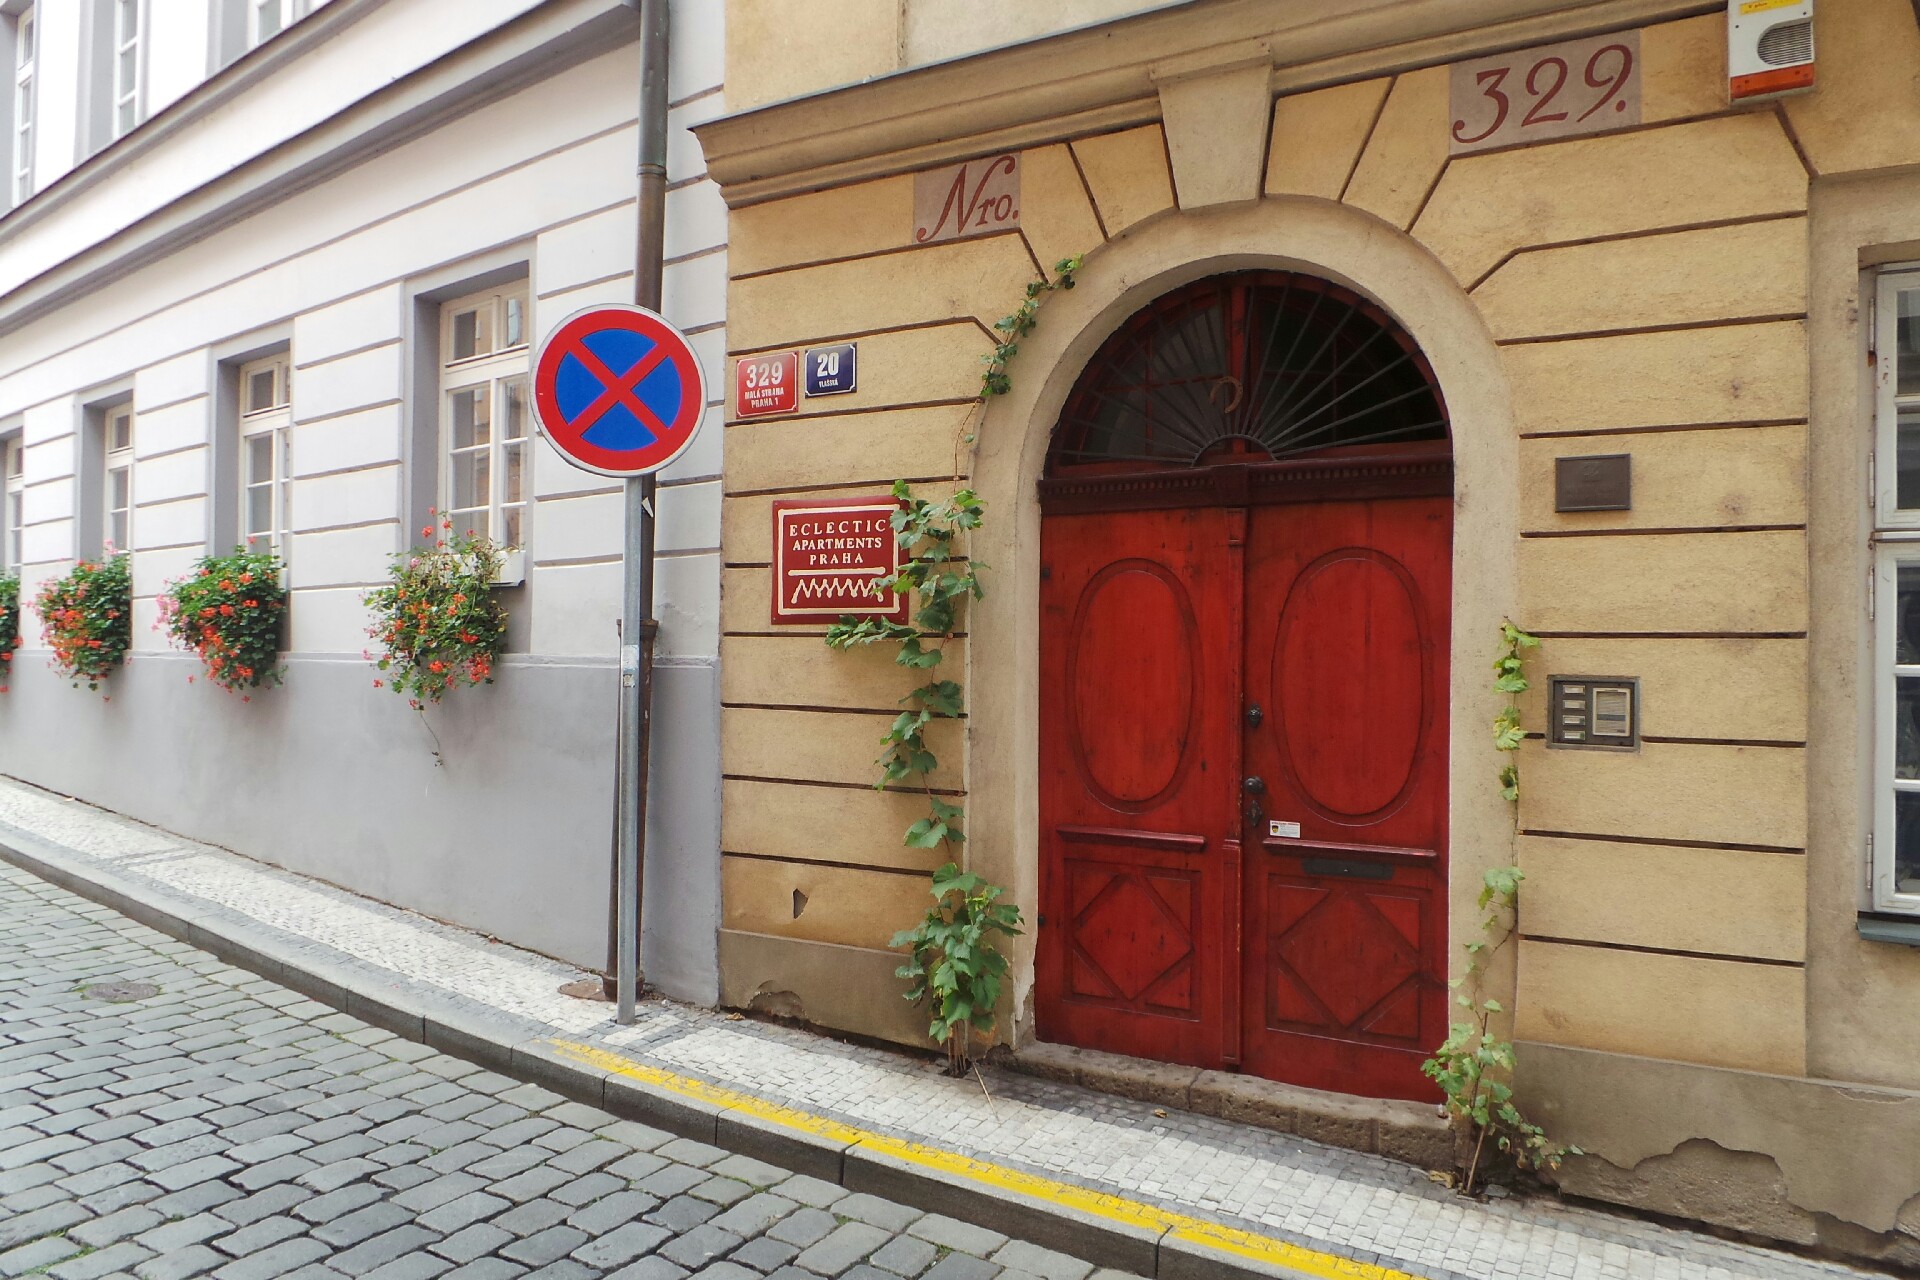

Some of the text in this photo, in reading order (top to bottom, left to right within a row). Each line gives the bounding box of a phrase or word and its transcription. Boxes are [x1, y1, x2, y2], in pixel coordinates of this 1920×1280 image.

[916, 155, 1019, 243] Nro.
[816, 352, 840, 378] 20
[746, 361, 783, 388] 329
[751, 397, 779, 408] PRAHA 1
[789, 519, 886, 537] ECLECTIC
[792, 537, 882, 551] APARTMENTS
[809, 552, 864, 566] PRAHA
